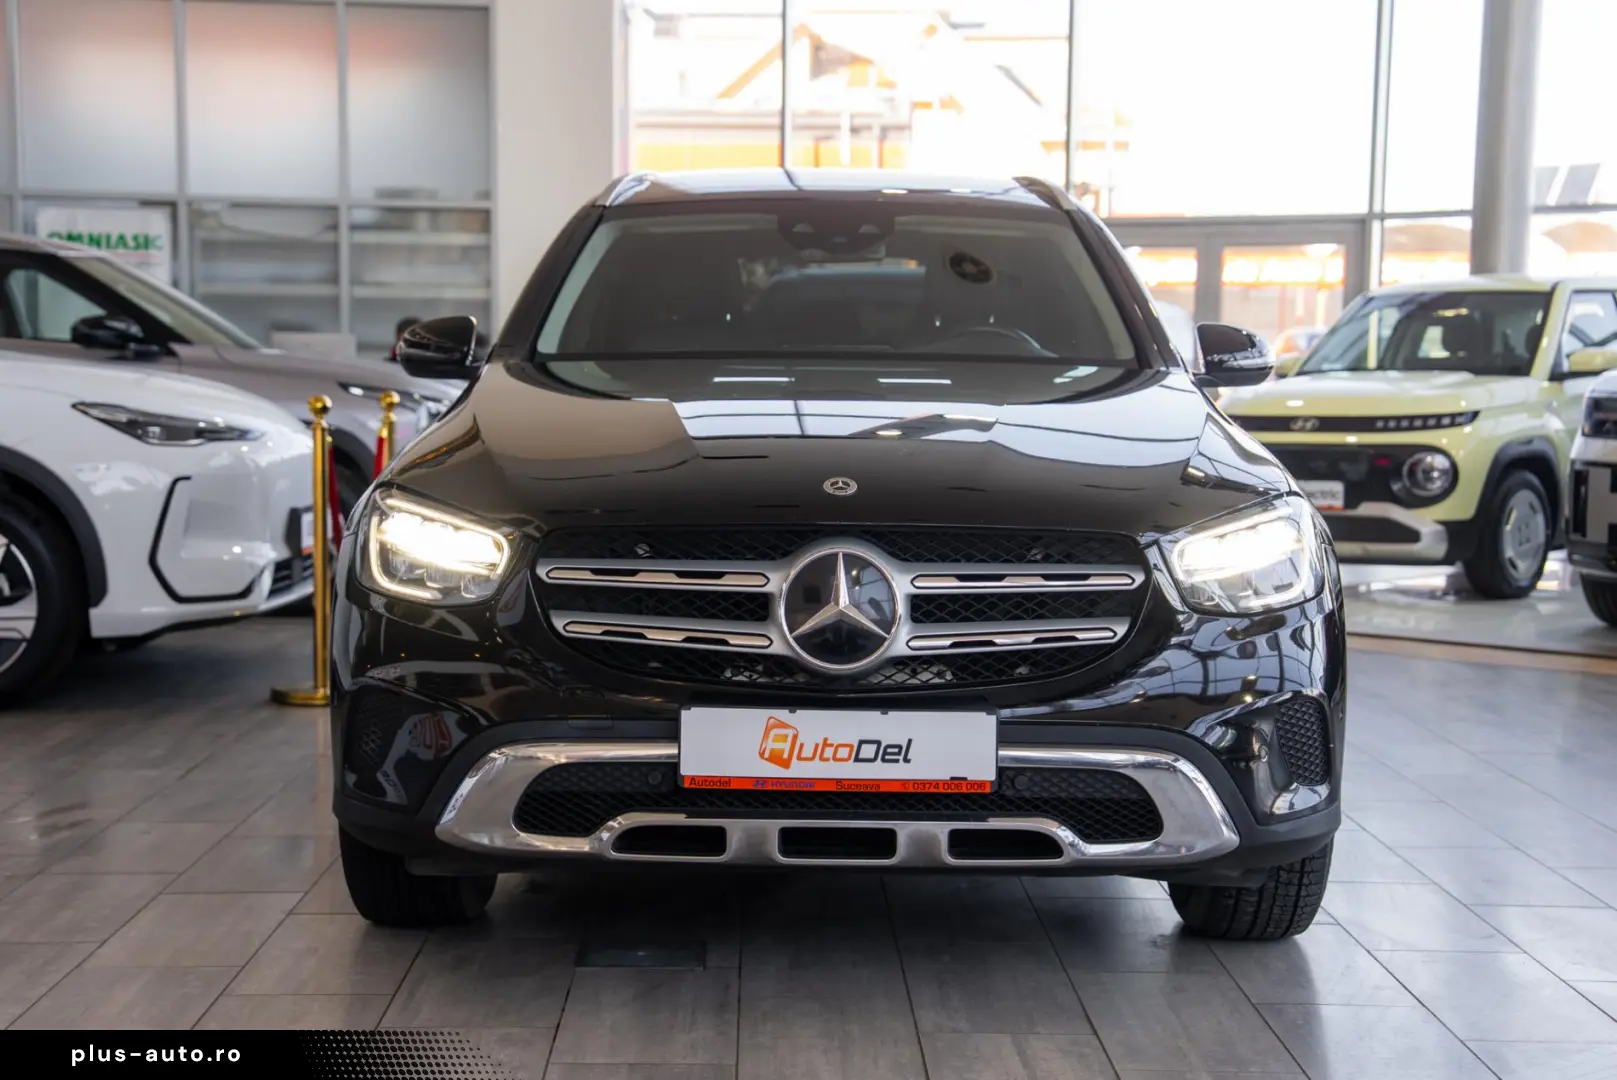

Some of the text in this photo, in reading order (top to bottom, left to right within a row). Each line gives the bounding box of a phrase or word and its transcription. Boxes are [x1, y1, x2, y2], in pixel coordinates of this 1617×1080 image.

[763, 727, 913, 764] AutoDel
[688, 777, 732, 788] Autodel
[835, 780, 881, 791] Suceava
[912, 782, 940, 791] 0374
